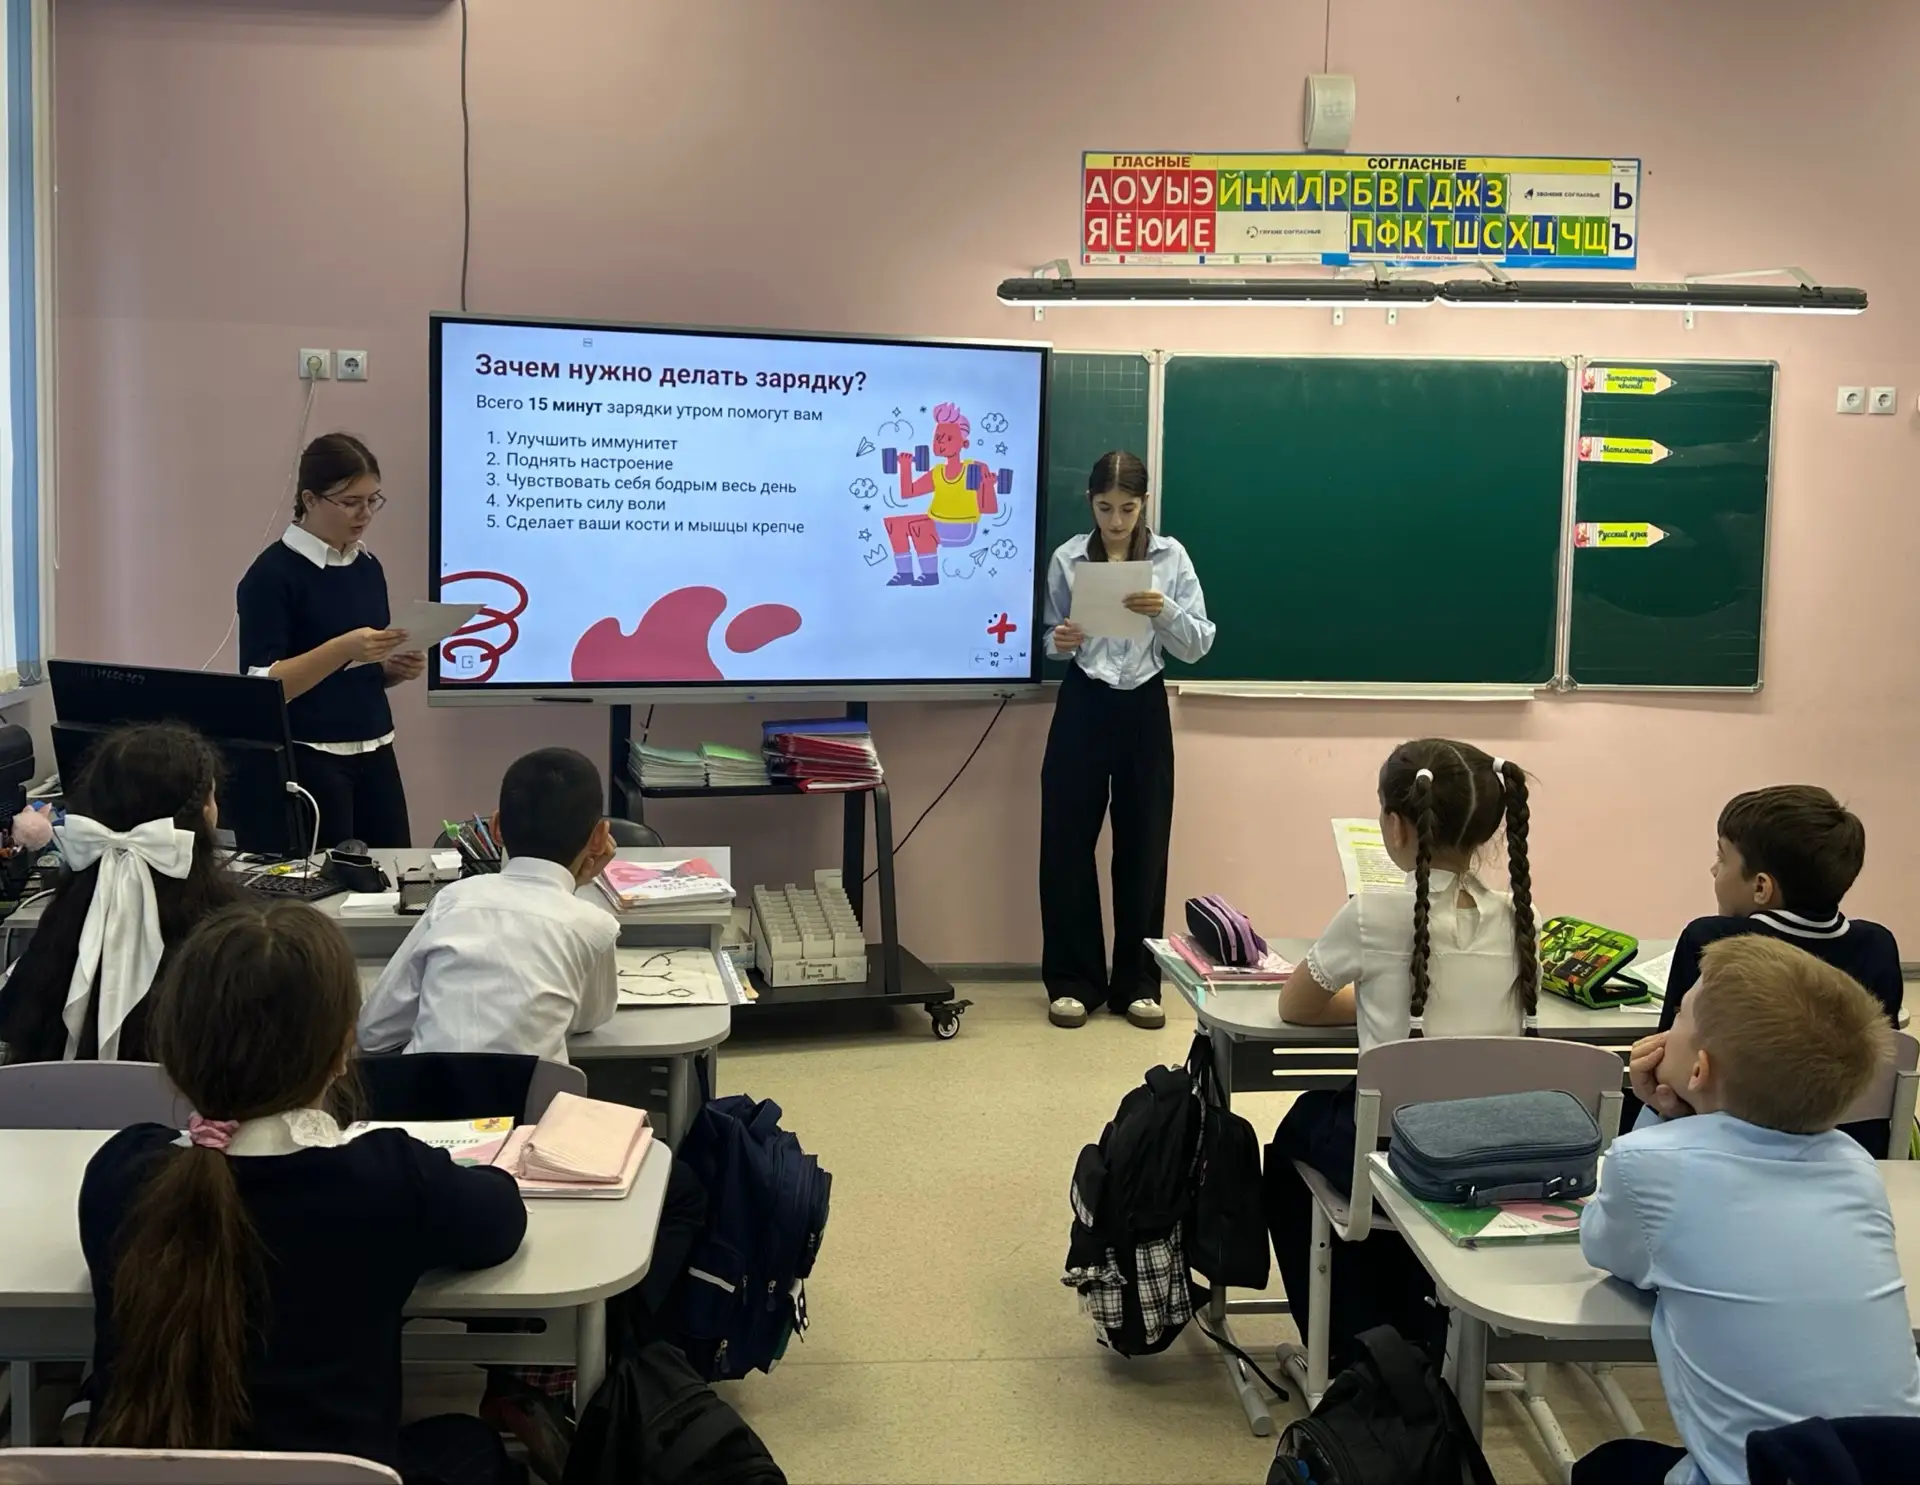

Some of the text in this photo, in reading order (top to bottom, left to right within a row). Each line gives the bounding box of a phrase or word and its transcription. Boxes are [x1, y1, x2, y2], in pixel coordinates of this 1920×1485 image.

[1113, 156, 1191, 168] ГЛАСНЫЕ
[1368, 158, 1467, 170] СОГЛАСНЫЕ
[475, 353, 867, 396] Зачем нужно делать зарядку?
[476, 395, 823, 423] Всего 15 минут зарядки утром помогут вам
[487, 431, 678, 452] 1. Улучшить иммунитет
[1600, 444, 1653, 455] Математика
[486, 452, 673, 472] 2. Поднять настроение
[486, 473, 797, 495] 3. Чувствовать себя бодрым весь день
[486, 494, 666, 513] 4. Укрепить силу воли
[486, 515, 805, 536] 5. Сделает ваши кости и мышцы крепче
[1598, 530, 1648, 541] Русский язык
